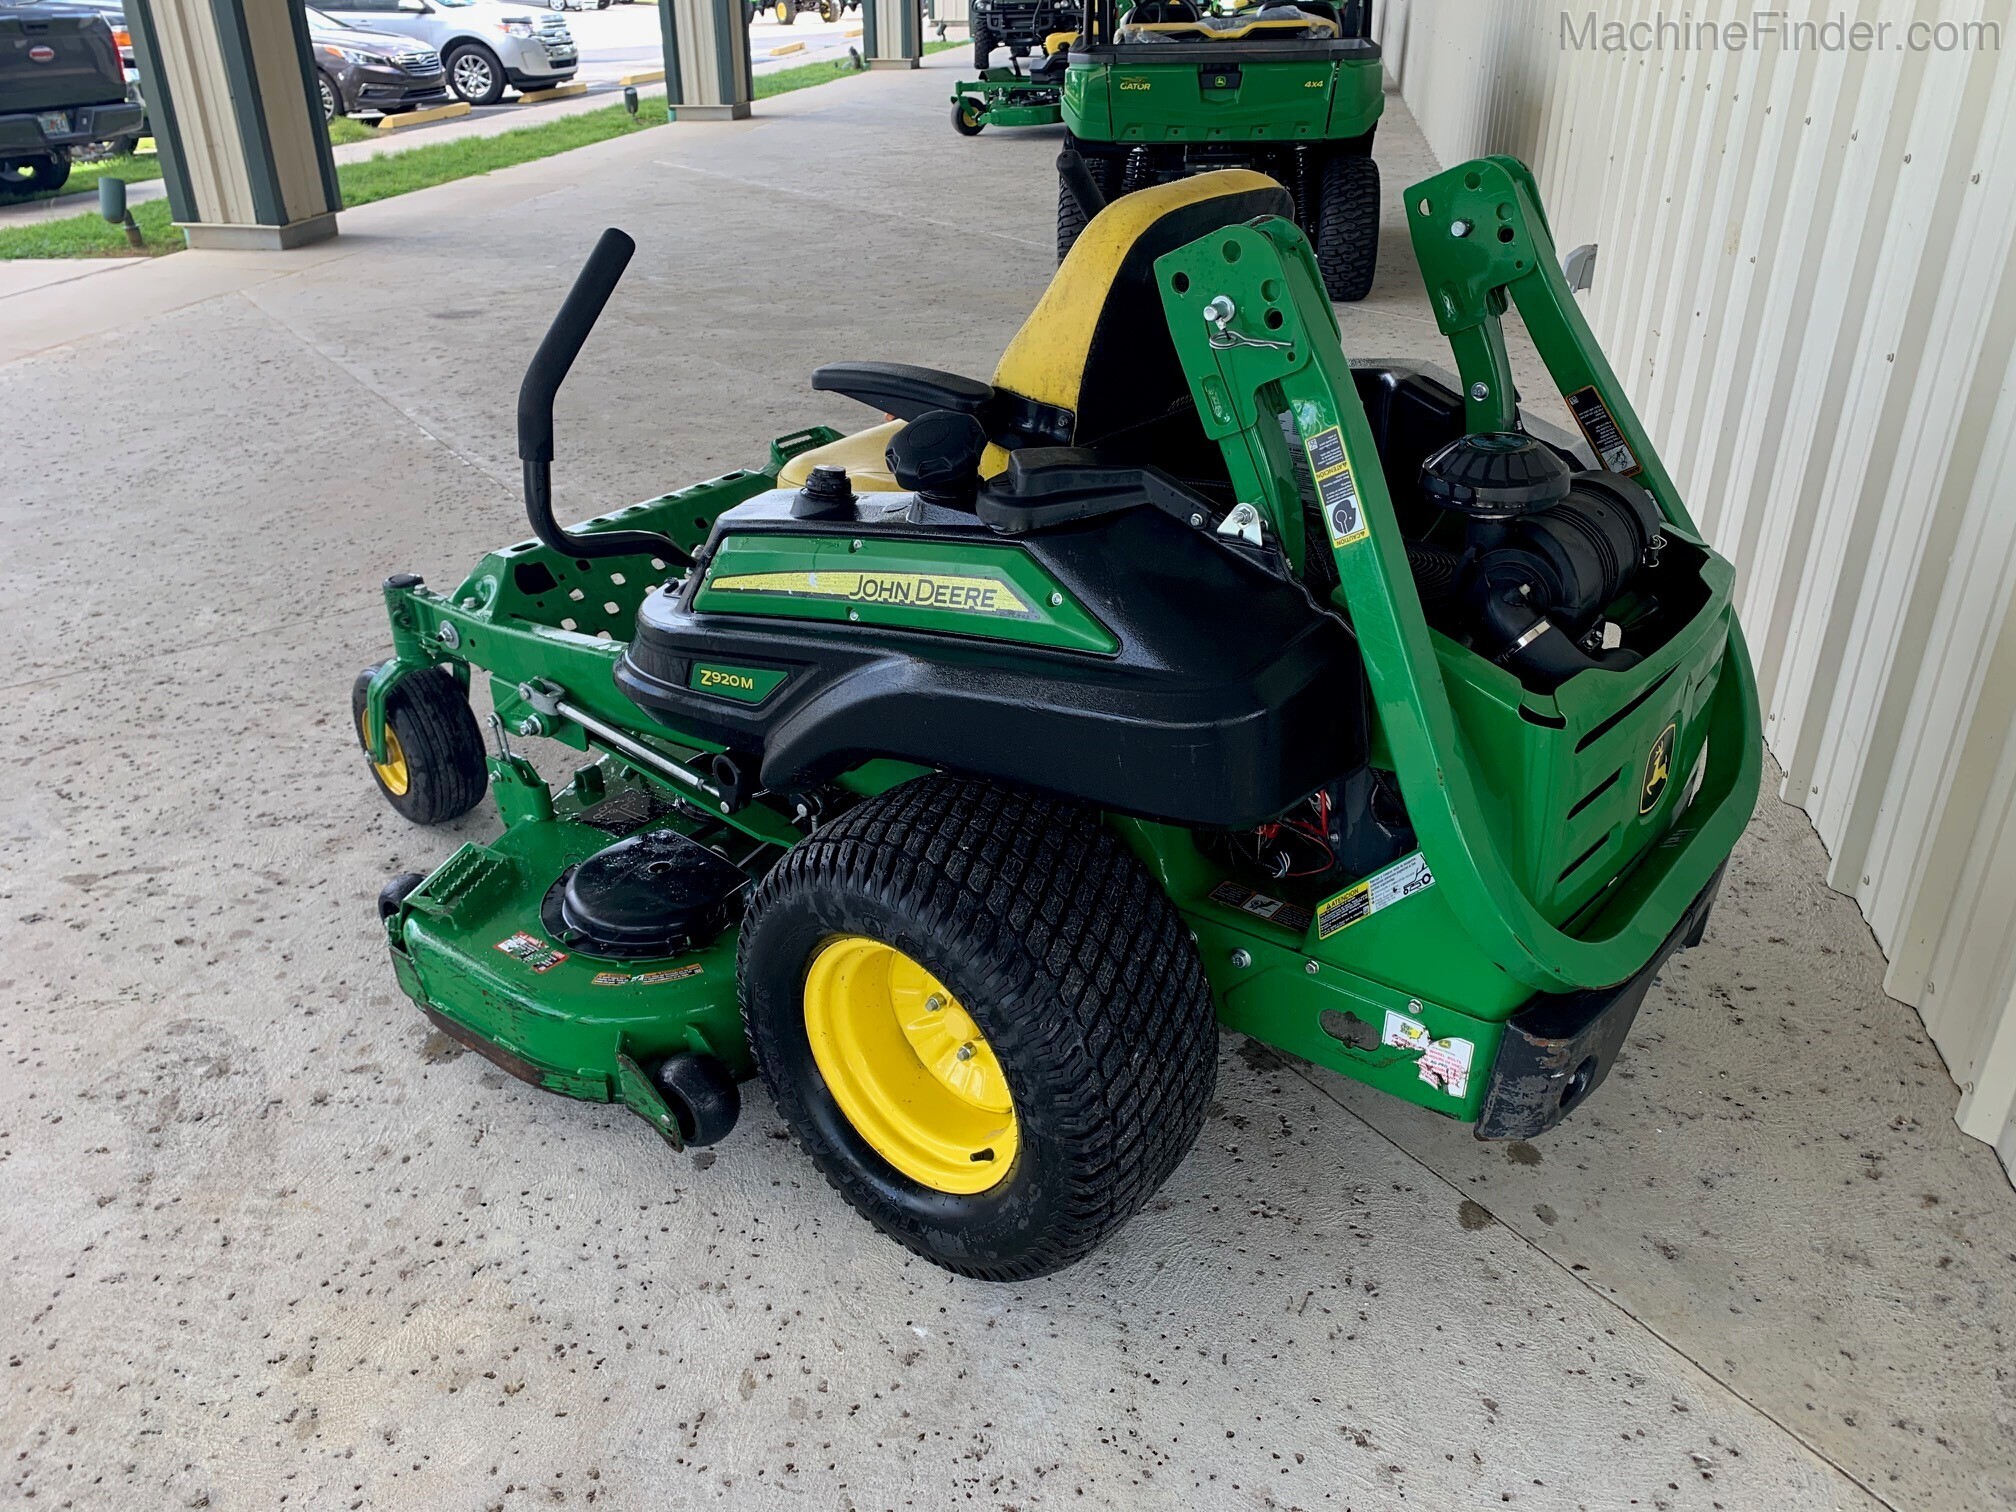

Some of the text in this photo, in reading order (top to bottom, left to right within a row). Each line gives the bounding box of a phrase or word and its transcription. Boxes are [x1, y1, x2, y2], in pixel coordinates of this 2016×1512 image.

[1120, 82, 1151, 91] GATOR
[1336, 532, 1361, 546] CAUTION
[850, 574, 998, 608] JOHN DEERE
[700, 669, 754, 690] Z920M
